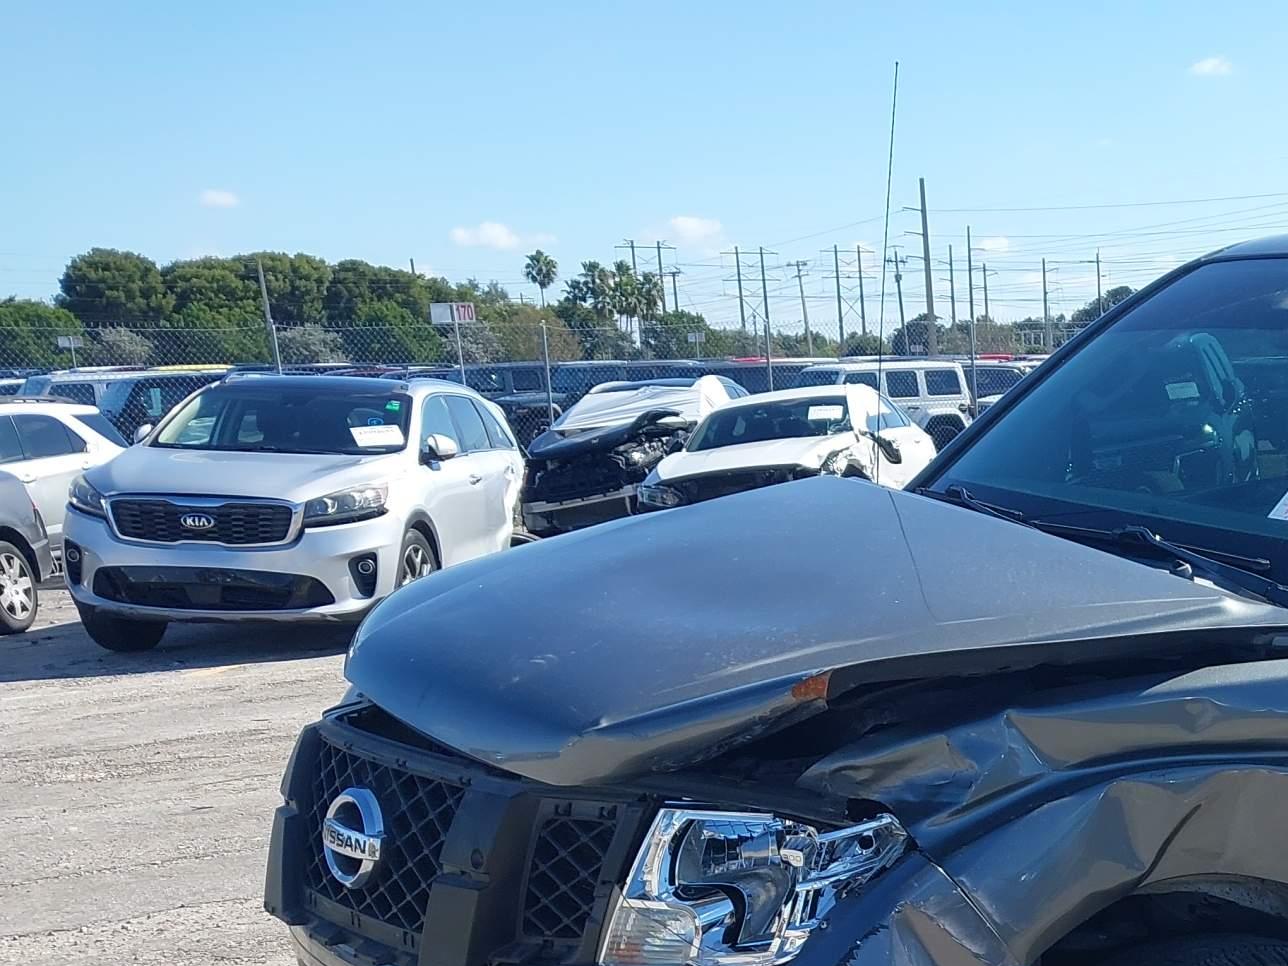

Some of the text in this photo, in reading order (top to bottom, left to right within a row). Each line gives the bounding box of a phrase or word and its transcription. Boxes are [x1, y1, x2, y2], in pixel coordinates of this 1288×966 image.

[457, 303, 474, 321] 170
[186, 516, 209, 526] KIA
[324, 827, 367, 855] NISSAN
